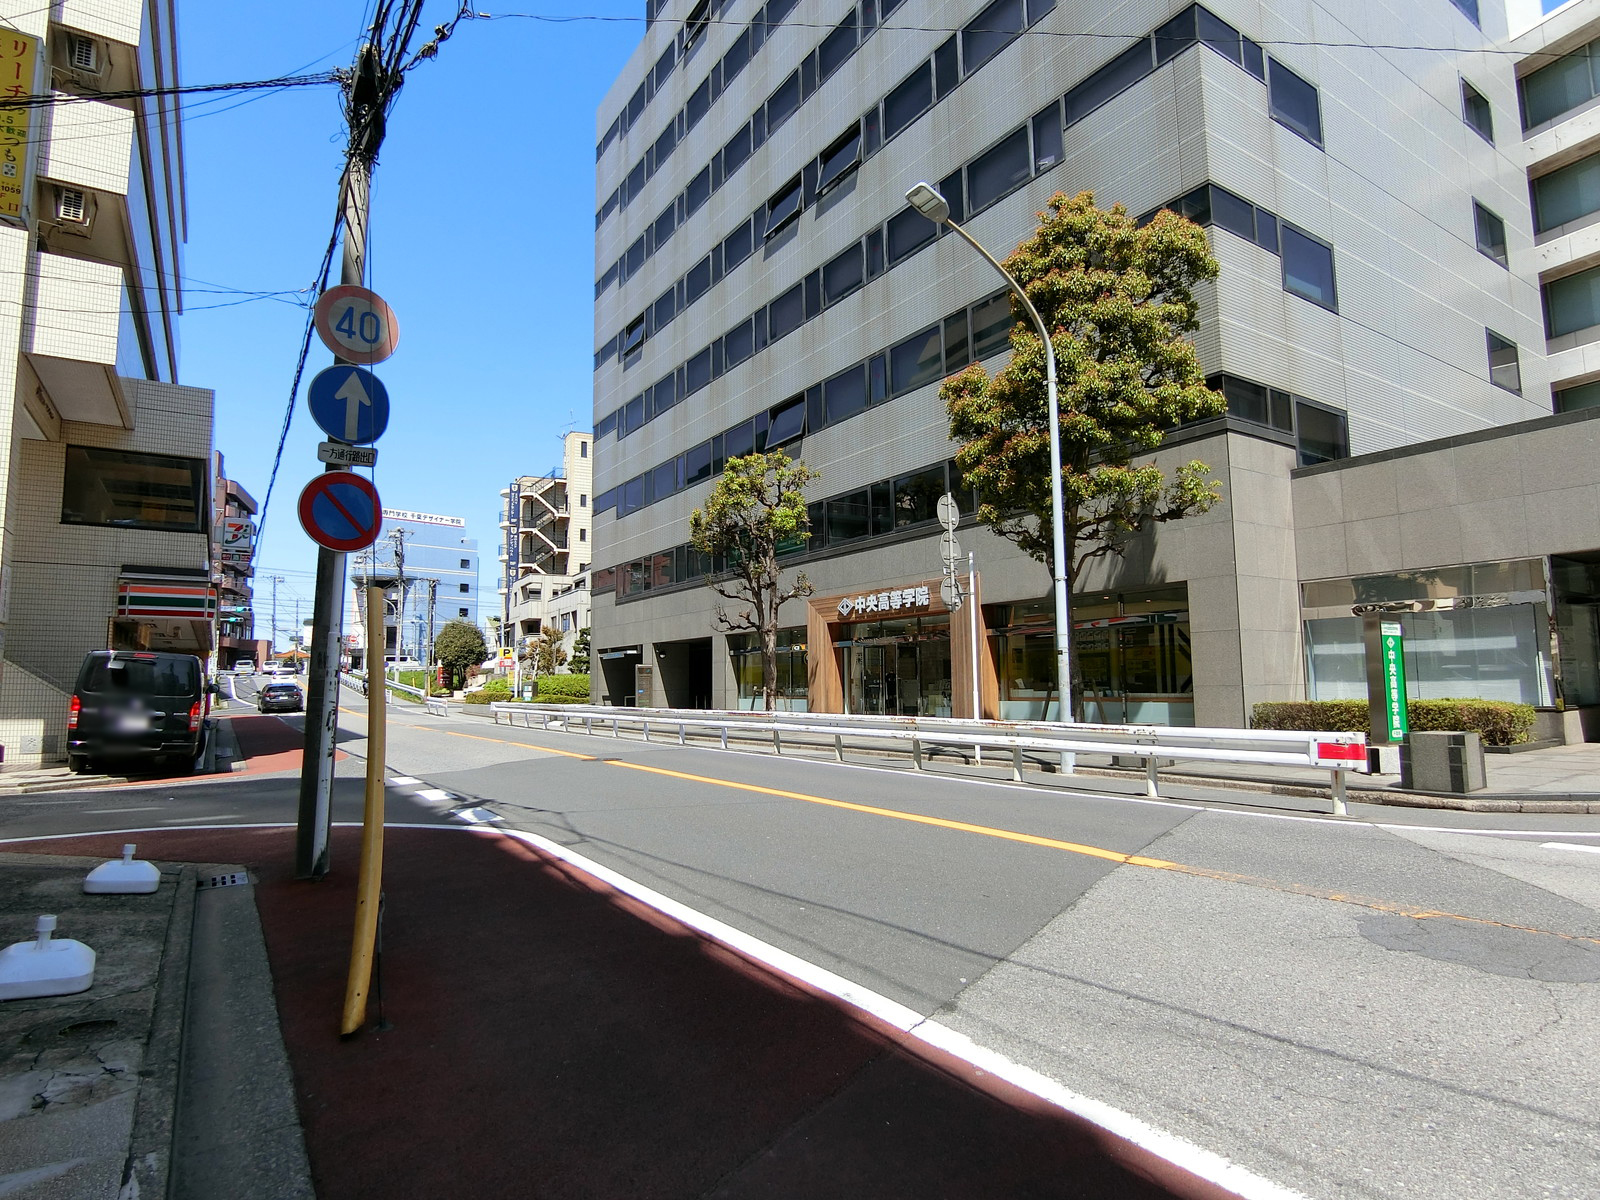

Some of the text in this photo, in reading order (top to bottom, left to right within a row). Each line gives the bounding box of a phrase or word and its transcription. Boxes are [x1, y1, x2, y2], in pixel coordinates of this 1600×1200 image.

[336, 306, 381, 344] 40
[322, 448, 375, 464] 一方通行路出口
[855, 586, 930, 614] 中央高等学院
[503, 648, 511, 656] P
[1388, 649, 1400, 729] 中央高等学院
